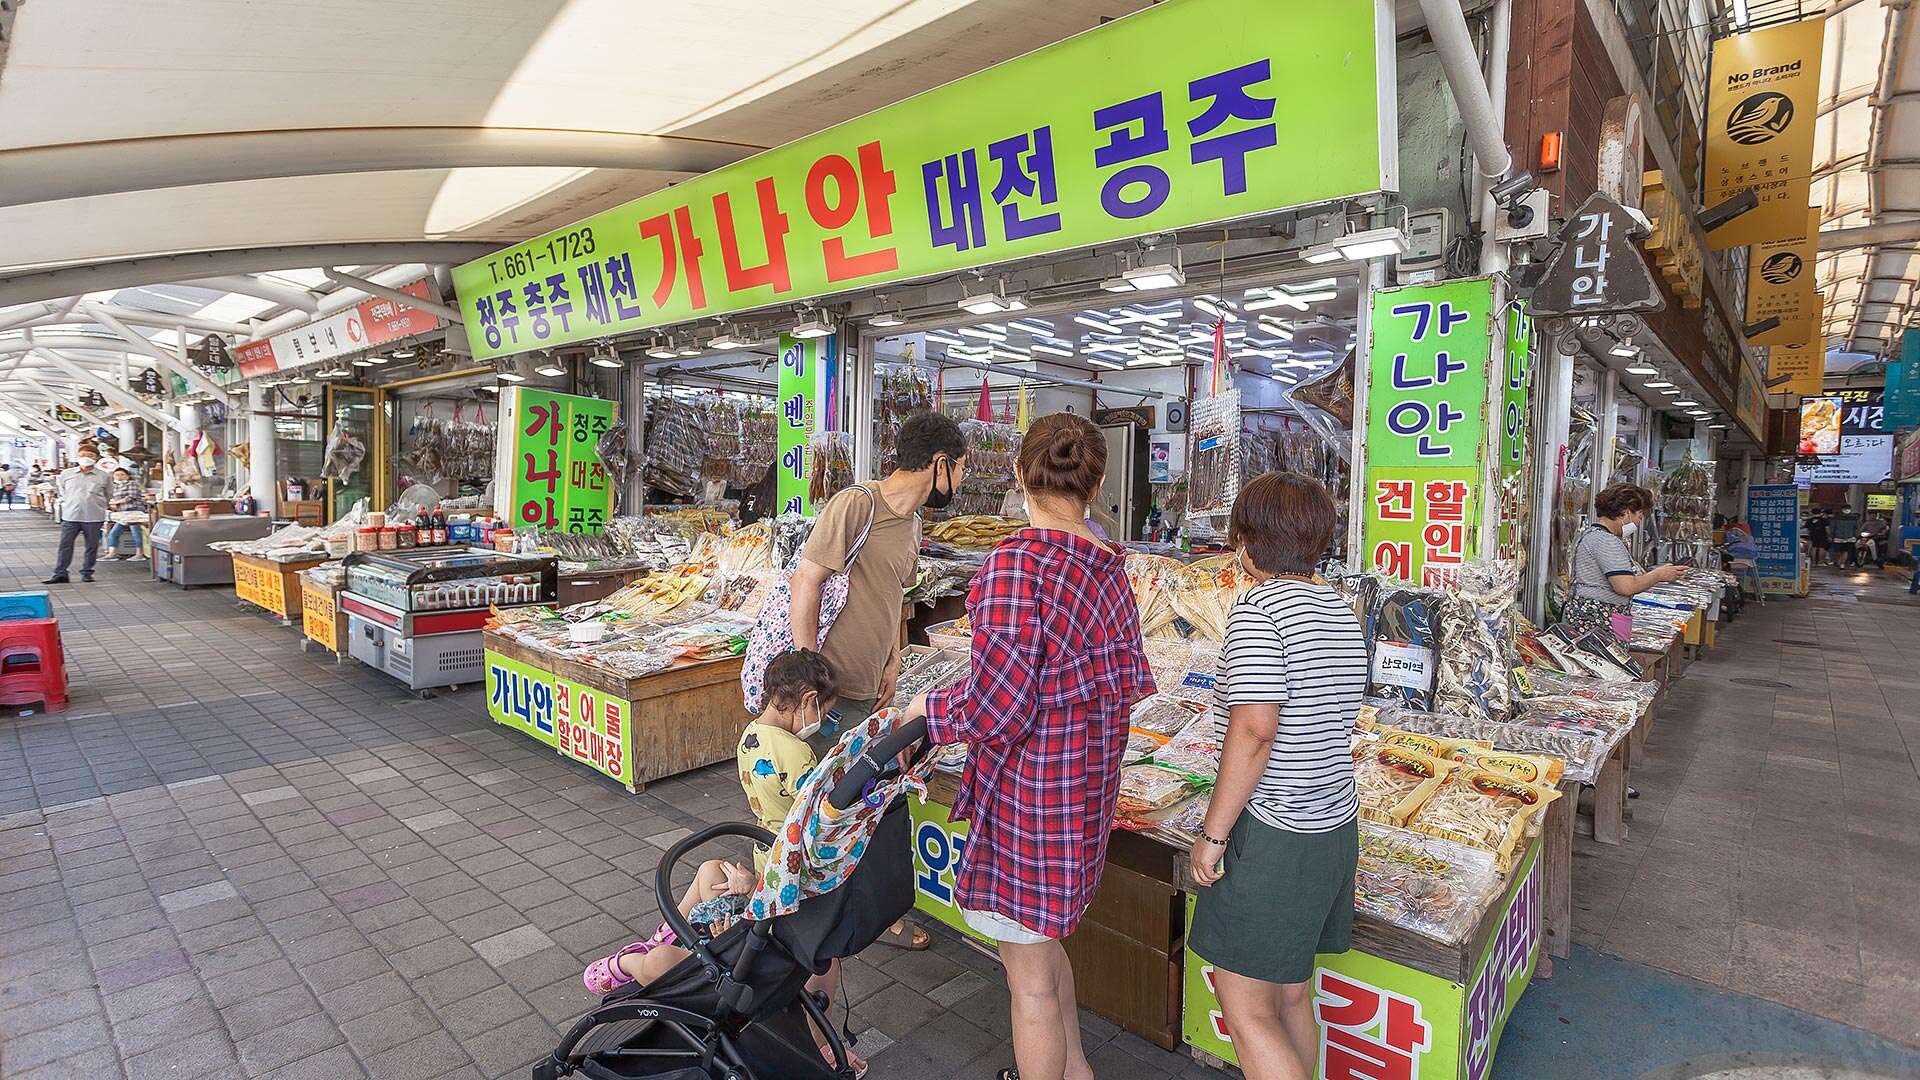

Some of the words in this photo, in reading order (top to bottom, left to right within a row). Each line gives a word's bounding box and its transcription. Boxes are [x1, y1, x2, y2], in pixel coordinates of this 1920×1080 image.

[1727, 73, 1750, 85] No
[1752, 59, 1802, 79] Brand
[475, 289, 520, 349] 청주
[523, 273, 573, 340] 충주
[577, 252, 642, 325] 제천
[639, 140, 900, 311] 가나안
[921, 125, 1062, 252] 대전
[1093, 58, 1277, 220] 공주
[487, 227, 596, 284] T.661-1723
[1572, 212, 1614, 305] 가나안
[1388, 303, 1468, 456] 가나안
[1506, 301, 1527, 460] 가나안
[573, 413, 608, 443] 청주
[571, 461, 605, 490] 대전
[568, 507, 603, 534] 공주
[1381, 656, 1424, 675] 산모미역
[491, 666, 553, 734] 가나안
[557, 684, 621, 740] 건어물
[558, 719, 623, 776] 할인매장
[637, 1009, 659, 1017] YOYO
